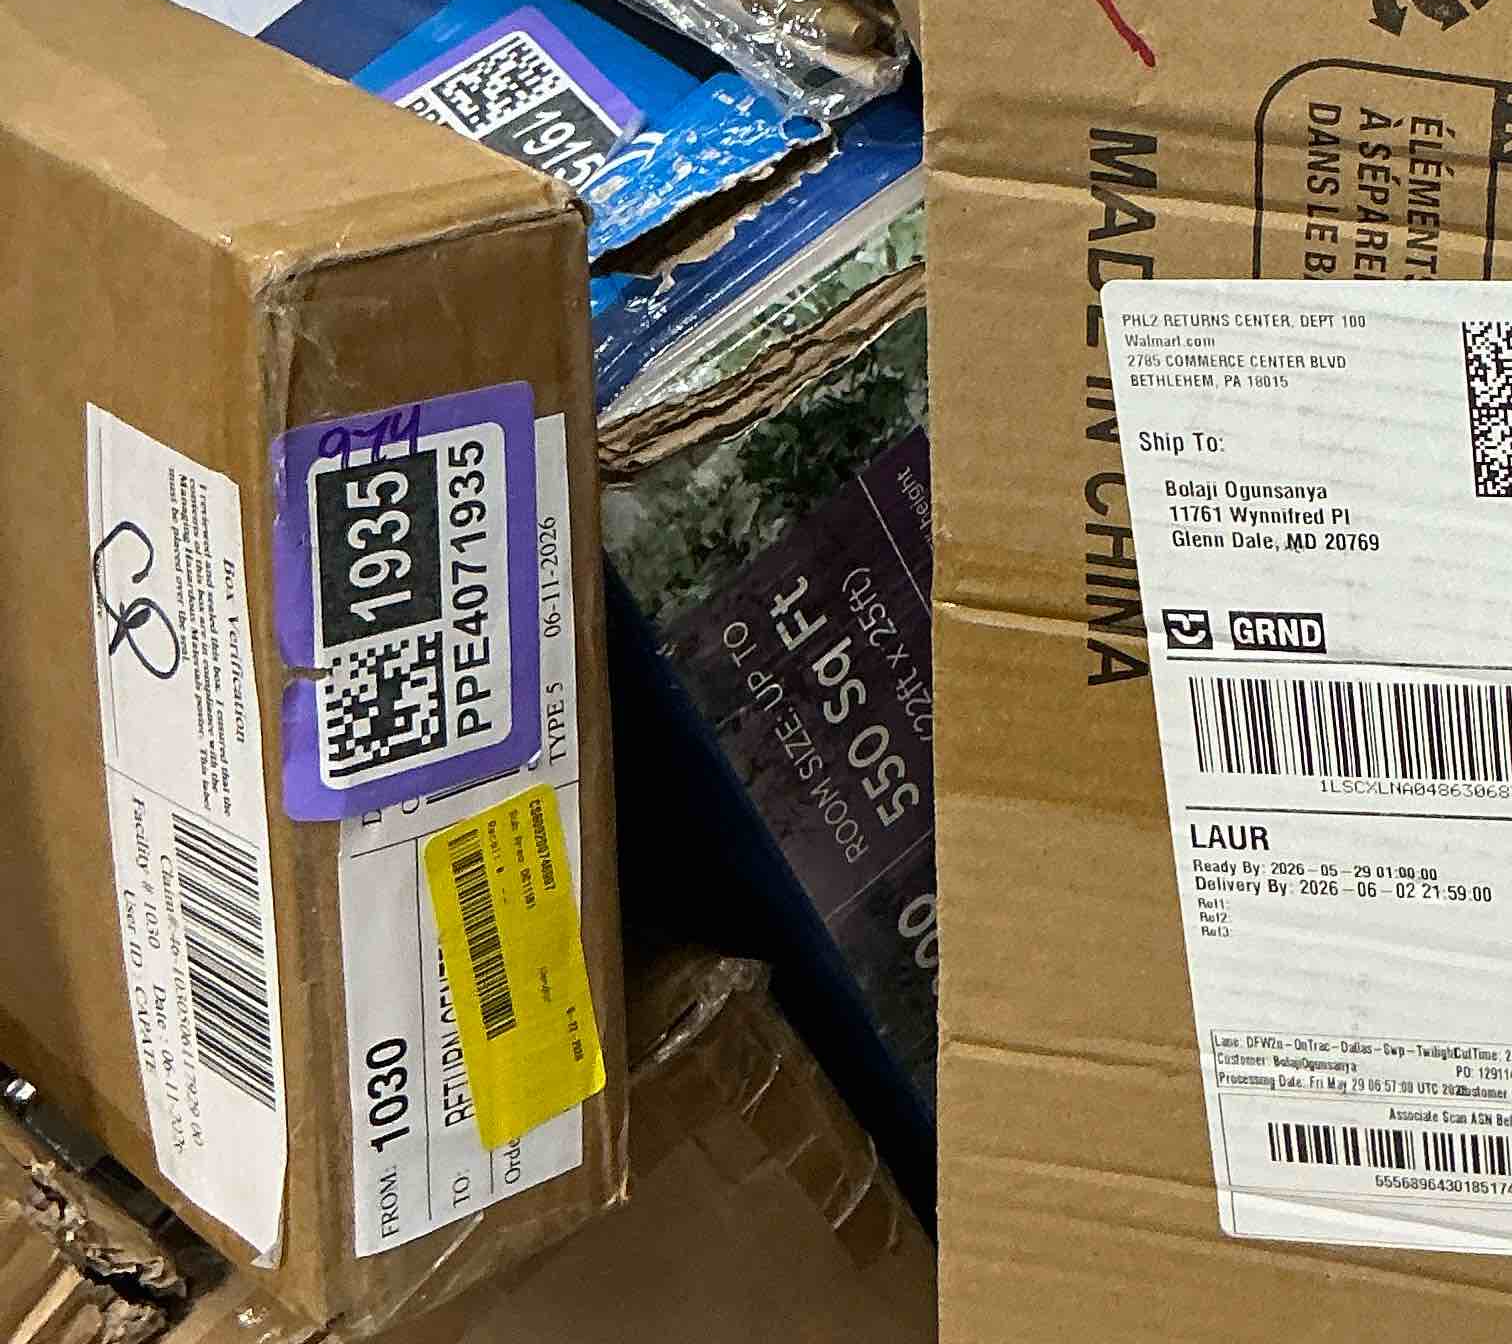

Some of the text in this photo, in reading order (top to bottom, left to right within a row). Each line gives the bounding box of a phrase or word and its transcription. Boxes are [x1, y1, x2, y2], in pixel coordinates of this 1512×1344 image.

[1306, 101, 1341, 243] DANS LE
[1163, 313, 1230, 328] RETURNS
[1300, 314, 1336, 328] DEPT
[1341, 314, 1367, 328] 100
[1124, 333, 1216, 348] Walmart.com
[1165, 354, 1246, 369] COMMERCE
[1249, 354, 1306, 369] CENTER
[1309, 355, 1347, 370] BLVD
[1223, 374, 1242, 388] PA
[1248, 374, 1289, 389] 18015
[1138, 431, 1225, 456] Ship To:
[1164, 479, 1328, 503] Bolaji Ogunsanya
[1168, 505, 1222, 524] 11761
[1229, 506, 1325, 528] Wynnifred
[346, 470, 412, 625] 1935
[1171, 529, 1380, 553] Glenn Dale, MD 20769
[445, 437, 494, 738] PPE4071935
[536, 514, 562, 640] 06-11-2026
[1083, 470, 1151, 688] CHINA
[770, 575, 829, 653] Ft
[1230, 616, 1324, 649] GRND
[220, 553, 251, 751] Box Verification
[811, 636, 866, 724] Sq
[545, 680, 568, 766] TYPE 5
[723, 621, 869, 865] ROOM SIZE: UP TO
[847, 724, 921, 828] 550
[1189, 823, 1270, 851] LAUR
[127, 791, 154, 876] Facility
[142, 897, 163, 954] 1030
[1192, 859, 1237, 876] Ready
[1242, 861, 1266, 877] By:
[1375, 866, 1438, 881] 01:00:00
[1195, 876, 1261, 896] Delivery
[1268, 879, 1294, 897] By:
[1422, 882, 1493, 903] 21:59:00
[1218, 1071, 1276, 1090] Processing
[1278, 1074, 1305, 1089] Date:
[1309, 1075, 1324, 1089] Fri
[1327, 1076, 1347, 1093] May
[1351, 1078, 1365, 1091] 29
[1416, 1081, 1438, 1095] UTC
[1388, 1107, 1439, 1122] Associate
[1442, 1110, 1468, 1124] Scan
[1469, 1112, 1493, 1126] ASN
[365, 1035, 409, 1239] FROM: 1030
[452, 1168, 472, 1209] TO:
